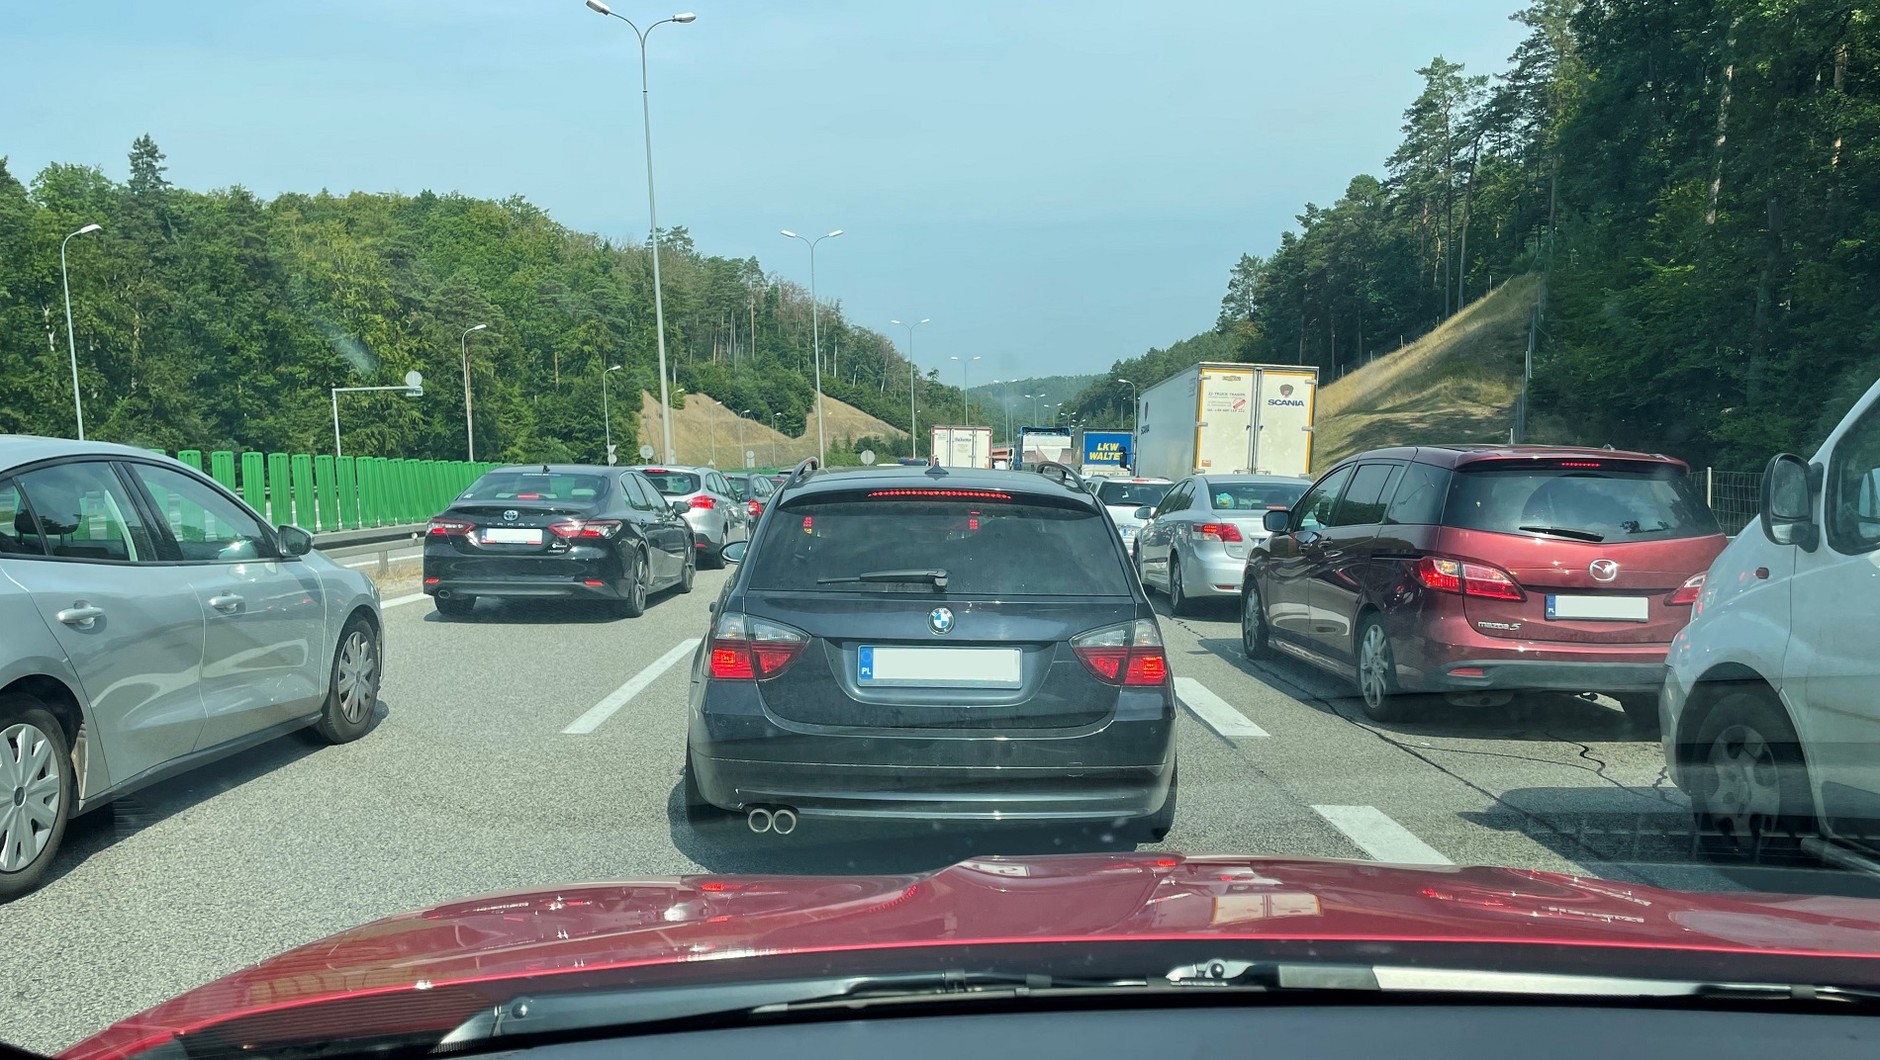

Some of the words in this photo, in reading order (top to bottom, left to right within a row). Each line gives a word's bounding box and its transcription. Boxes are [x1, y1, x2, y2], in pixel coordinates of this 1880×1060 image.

[1268, 399, 1304, 407] SCANIA
[1097, 442, 1119, 451] LKW
[1089, 452, 1121, 460] WALTE
[861, 667, 872, 675] PL
